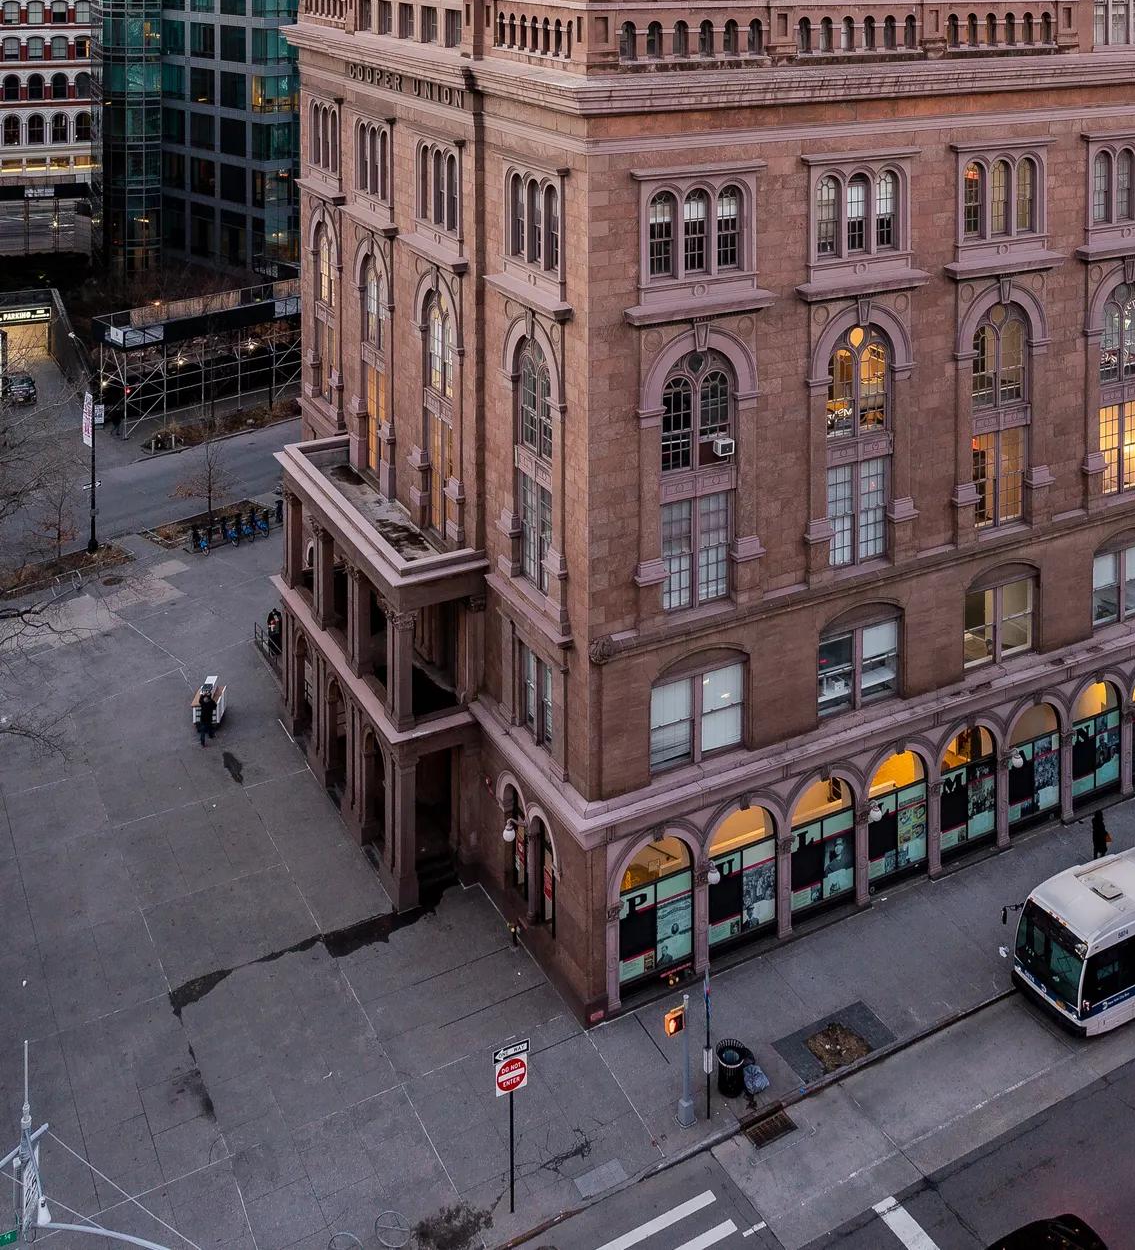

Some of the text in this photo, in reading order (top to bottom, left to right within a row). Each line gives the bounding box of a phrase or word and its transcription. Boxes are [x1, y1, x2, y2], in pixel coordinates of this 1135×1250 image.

[348, 63, 463, 109] COOPER UNION
[626, 893, 648, 918] P
[511, 1062, 521, 1070] NOT
[502, 1077, 520, 1087] ENTER
